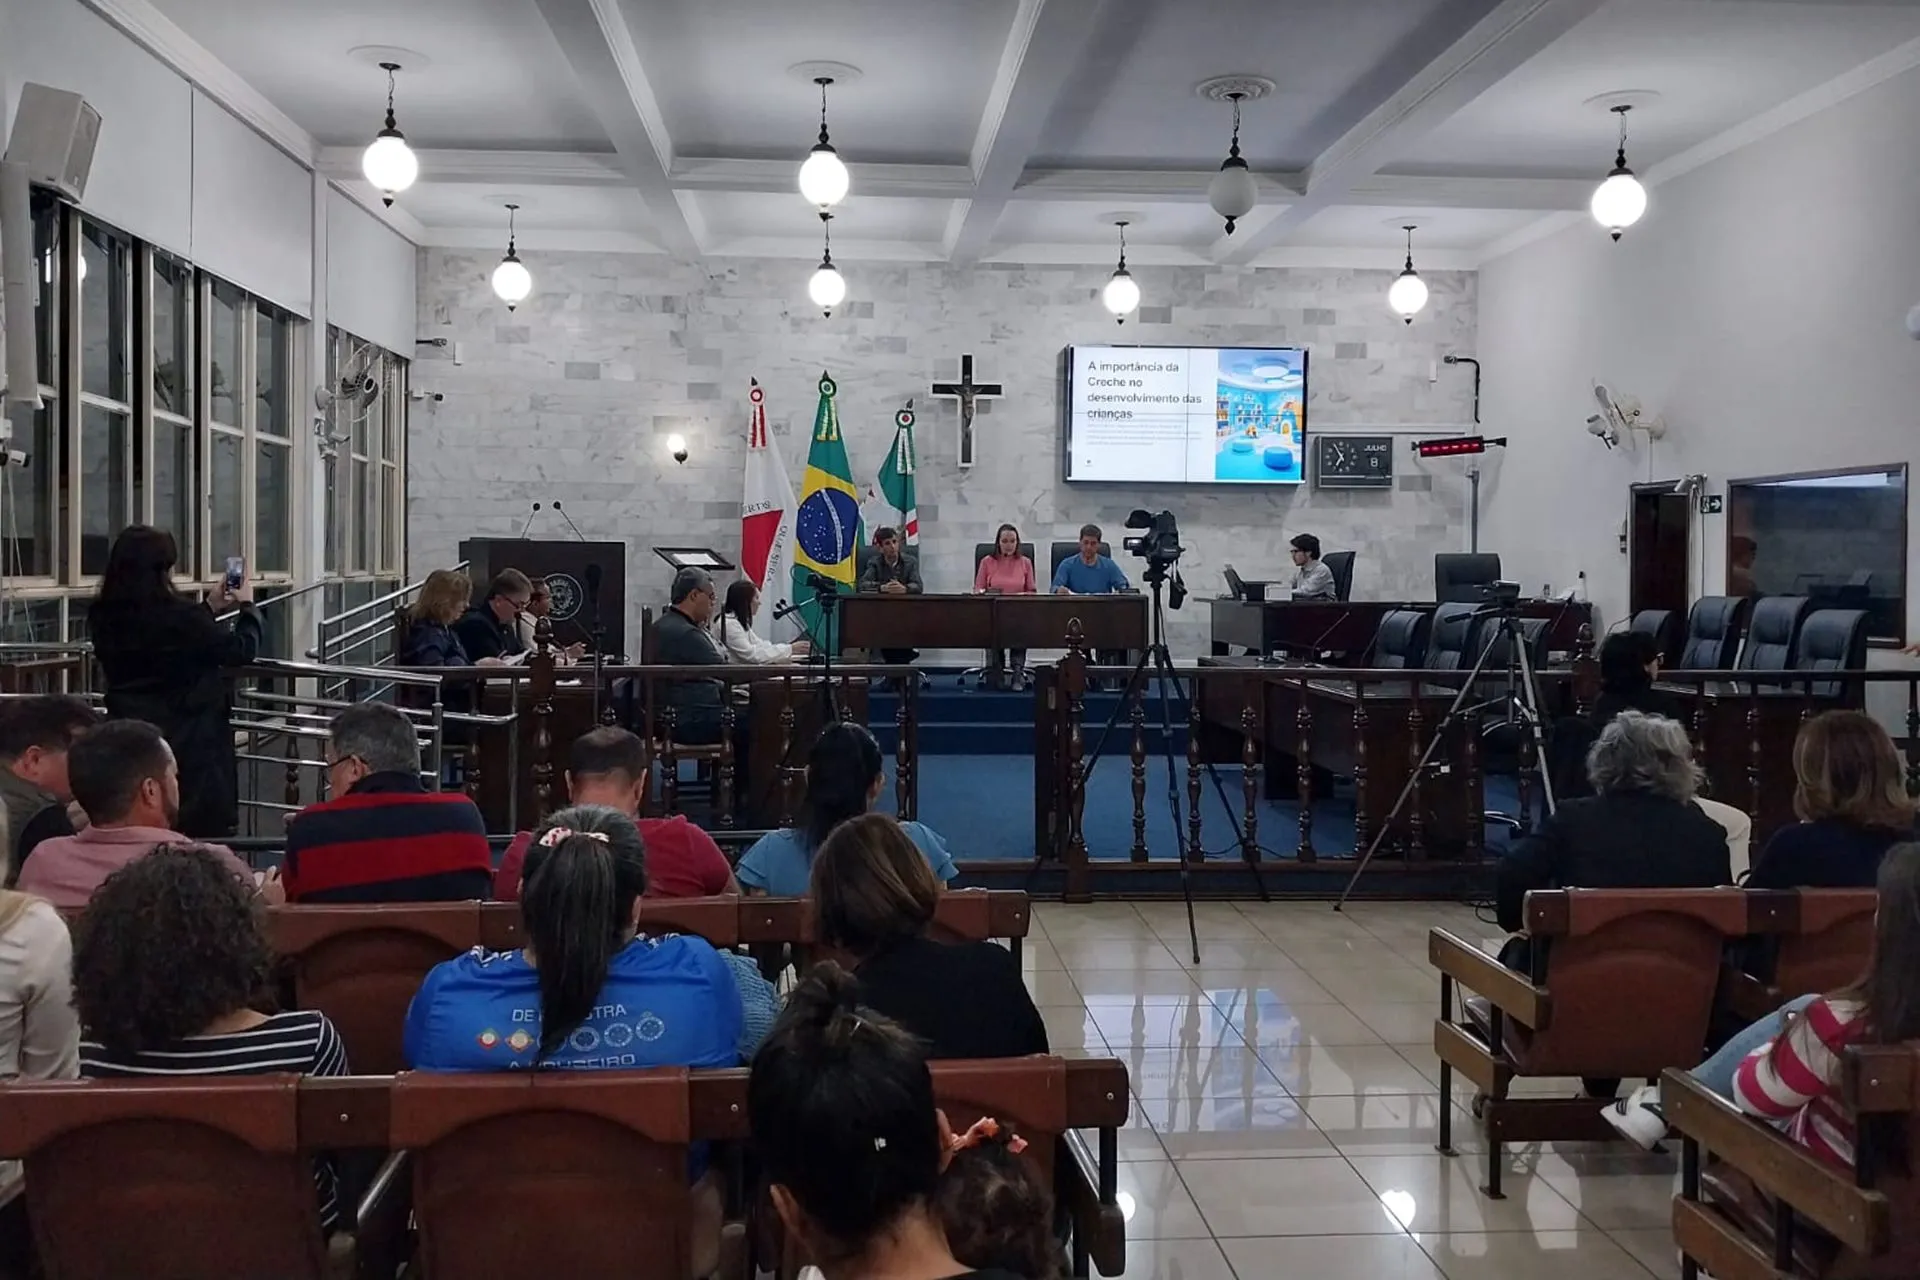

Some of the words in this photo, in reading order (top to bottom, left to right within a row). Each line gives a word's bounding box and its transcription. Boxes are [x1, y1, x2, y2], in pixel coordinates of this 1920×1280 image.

[1088, 361, 1097, 371] A
[1100, 361, 1163, 373] importância
[1165, 362, 1179, 372] da
[1087, 376, 1126, 387] Creche
[1129, 378, 1143, 387] no
[1087, 393, 1180, 403] desenvolvimento
[1182, 393, 1202, 404] das
[1087, 408, 1133, 421] crianças
[1370, 457, 1378, 467] 8
[512, 1008, 535, 1022] DE
